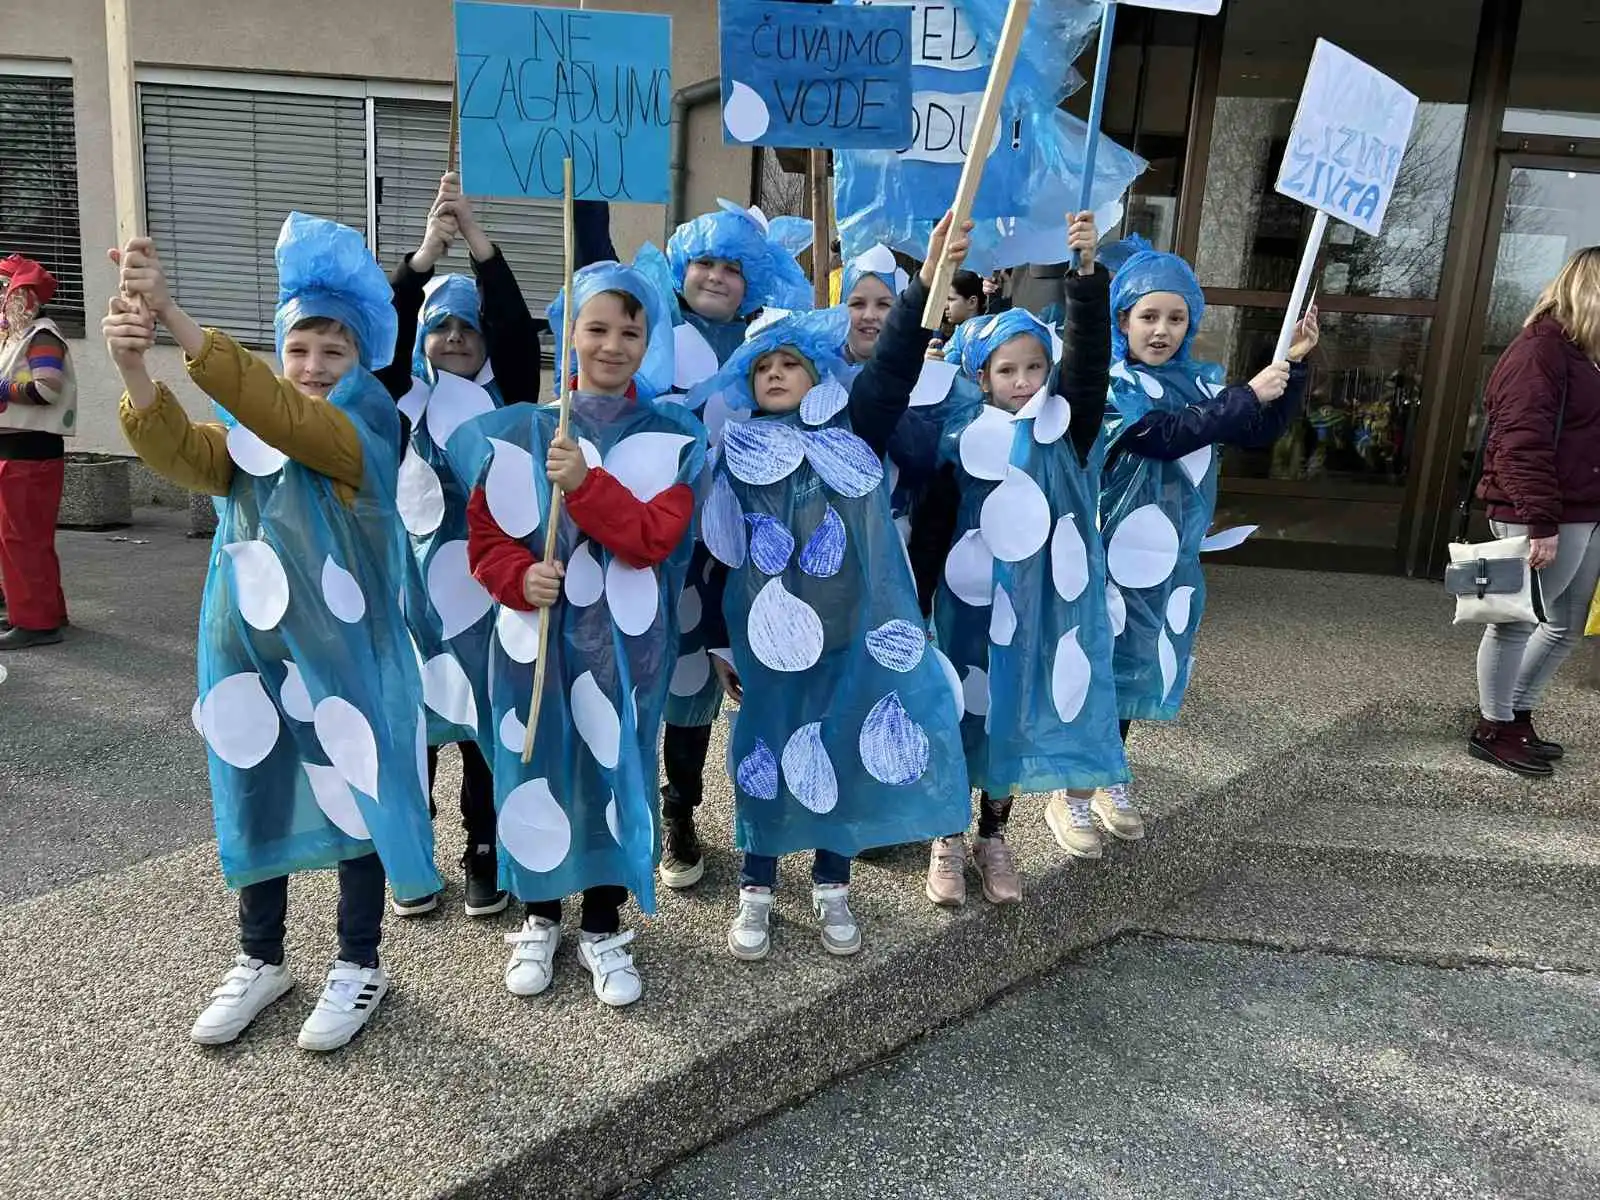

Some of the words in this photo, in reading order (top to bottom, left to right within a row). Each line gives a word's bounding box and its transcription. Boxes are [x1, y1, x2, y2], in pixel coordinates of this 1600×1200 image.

[534, 11, 593, 63] NE
[752, 15, 903, 71] ČUVAJMO
[773, 79, 889, 130] VODE
[497, 122, 632, 200] VODU
